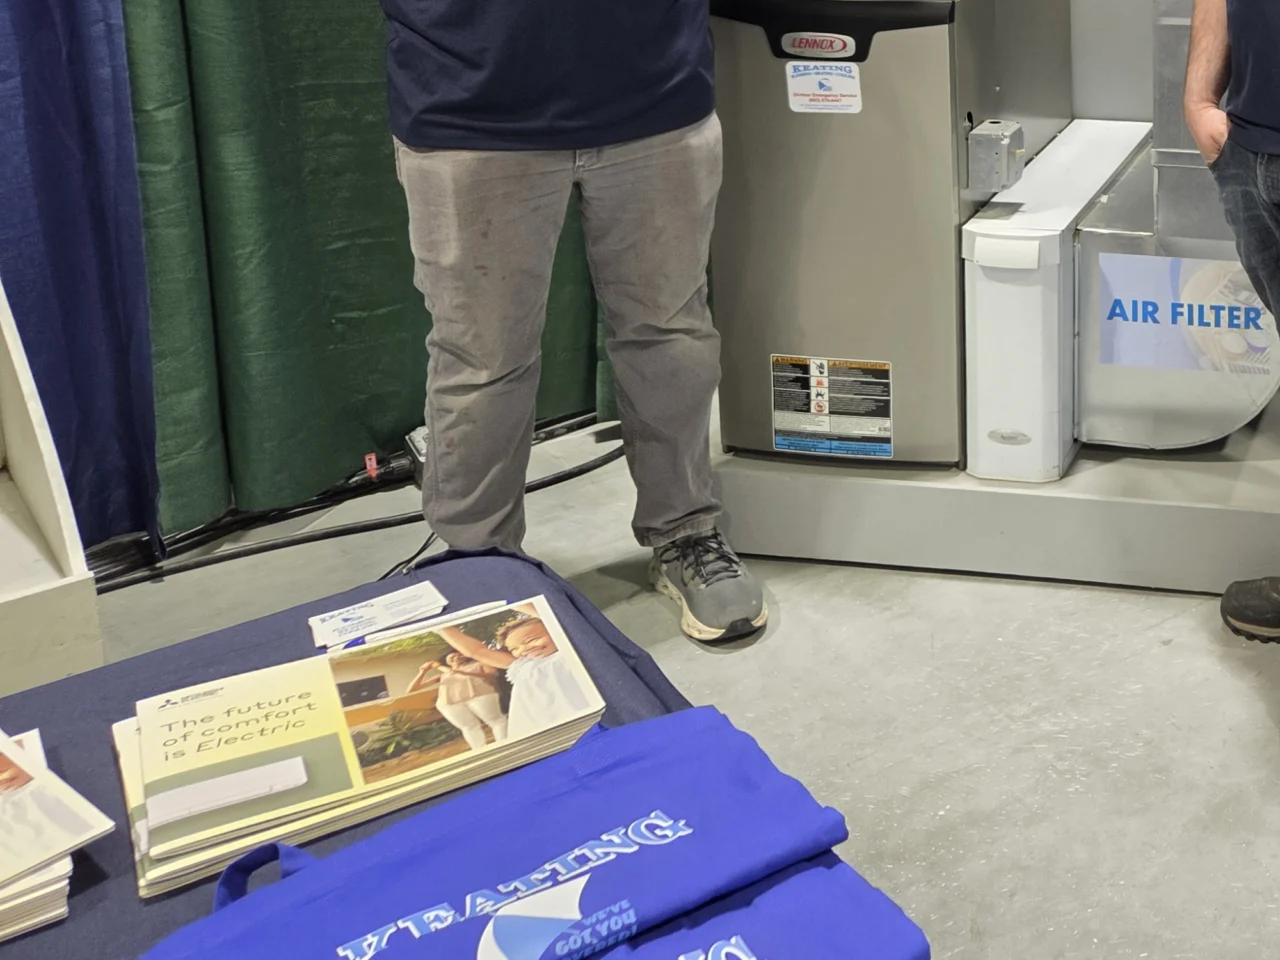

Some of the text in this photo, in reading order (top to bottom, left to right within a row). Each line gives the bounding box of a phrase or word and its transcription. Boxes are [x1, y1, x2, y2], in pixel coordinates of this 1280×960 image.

[792, 37, 835, 50] LENNOX
[792, 65, 852, 73] KEATING
[1107, 298, 1263, 330] AIR FILTER
[160, 715, 214, 733] The
[223, 691, 312, 718] future
[163, 703, 318, 748] of comfort
[164, 719, 306, 762] is Electric
[583, 897, 632, 927] WE'VE
[555, 908, 638, 956] GOT YOU
